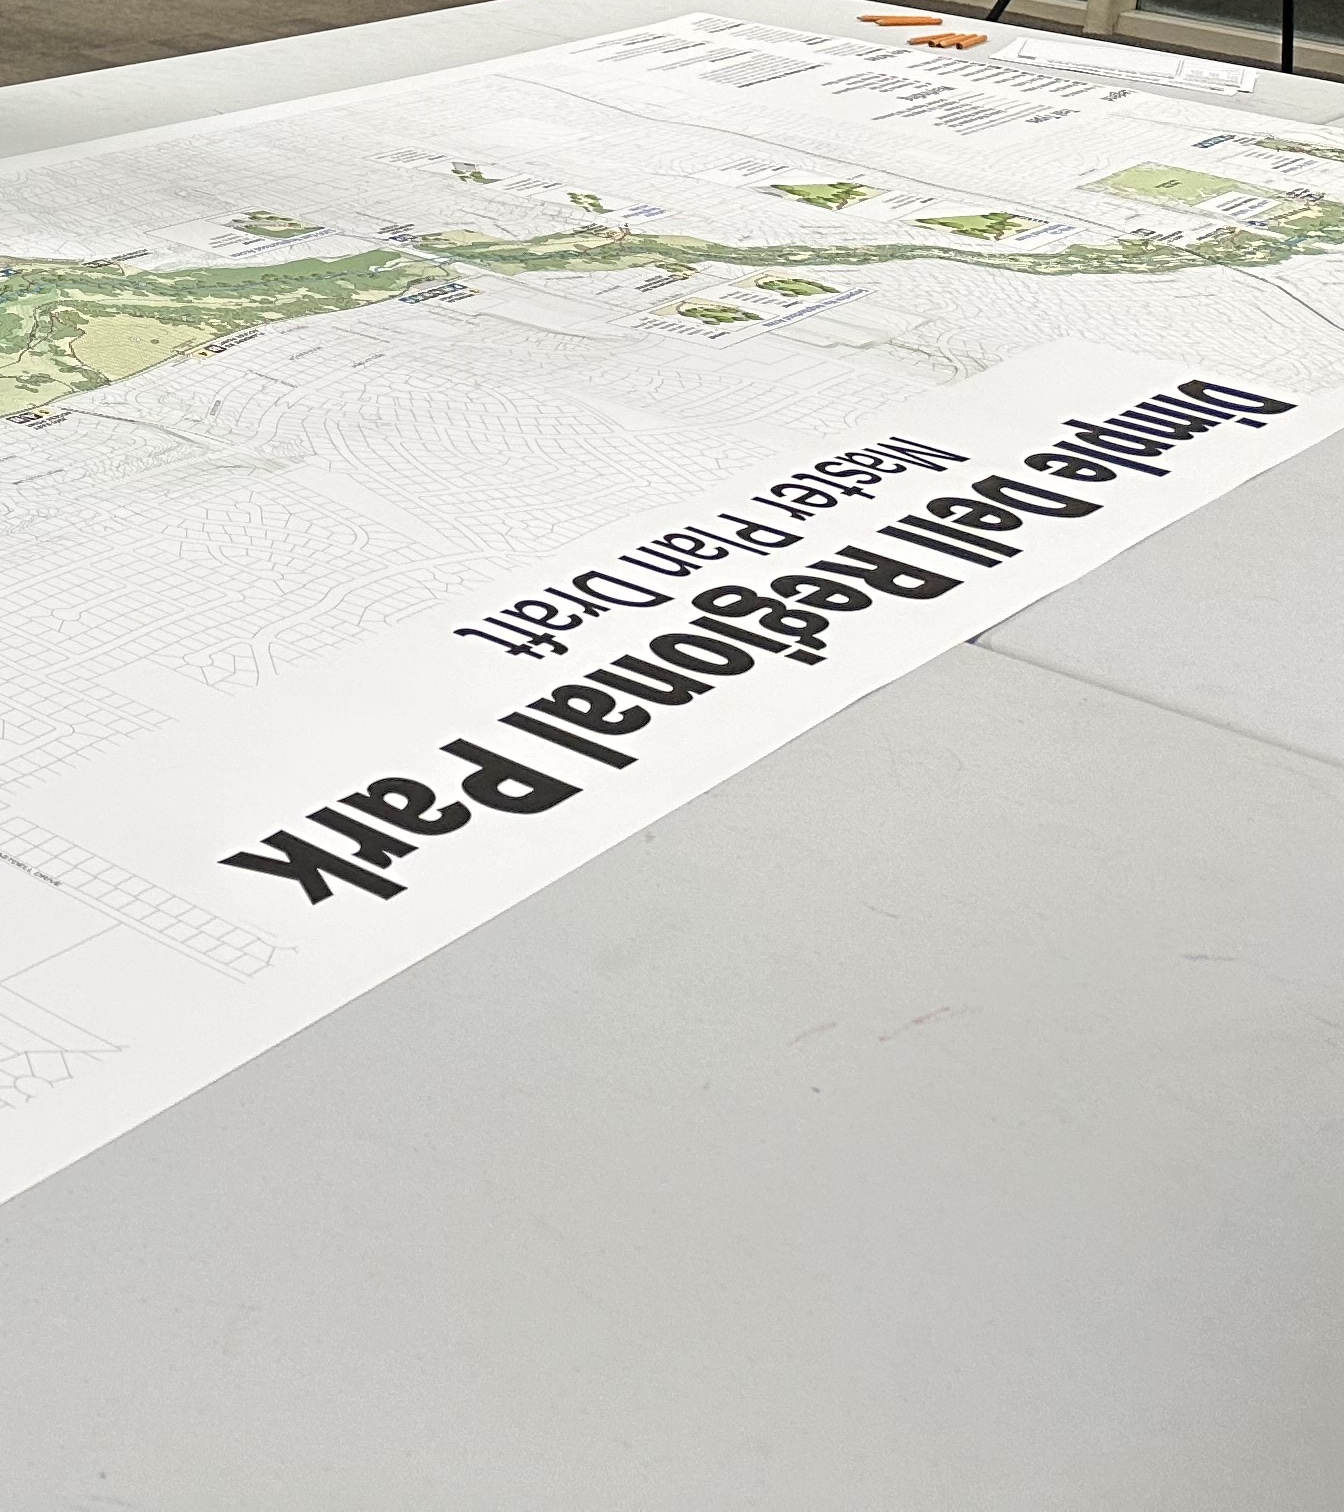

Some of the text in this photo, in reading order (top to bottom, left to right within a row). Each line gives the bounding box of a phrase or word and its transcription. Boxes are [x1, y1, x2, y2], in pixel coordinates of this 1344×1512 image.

[217, 378, 1298, 906] Dimple Dell Regional Park
[453, 436, 972, 660] Master Plan Draft
